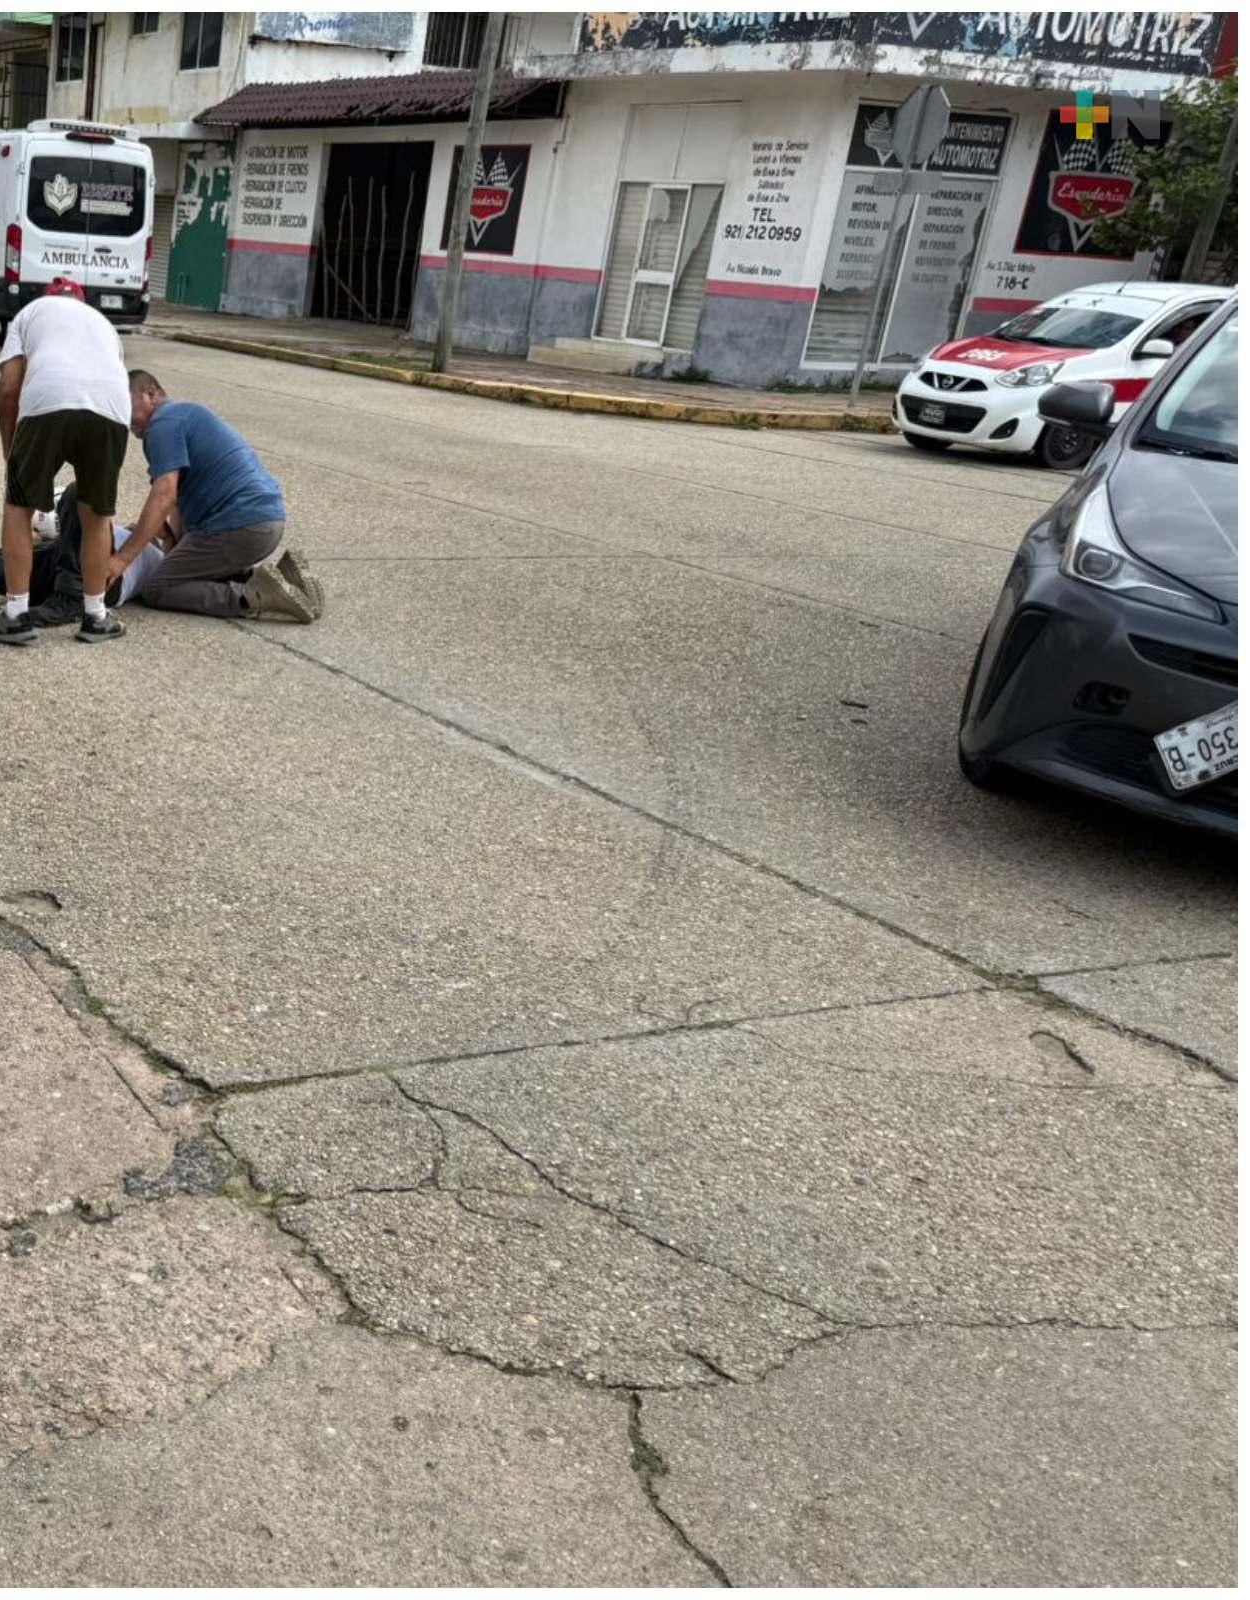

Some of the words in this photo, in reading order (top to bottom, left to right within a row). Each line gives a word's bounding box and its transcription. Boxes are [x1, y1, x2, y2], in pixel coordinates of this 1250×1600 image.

[663, 12, 851, 32] AUTOM
[944, 122, 1006, 143] NTENIMIENTO
[930, 144, 1000, 169] AUTOMOTRIZ
[931, 189, 972, 202] EPARACIÓN
[753, 207, 776, 222] TEL.
[724, 224, 743, 240] 921
[745, 225, 767, 241] 212
[768, 226, 802, 242] 0959
[41, 251, 131, 269] AMBULANCIA
[997, 276, 1030, 290] 718-C
